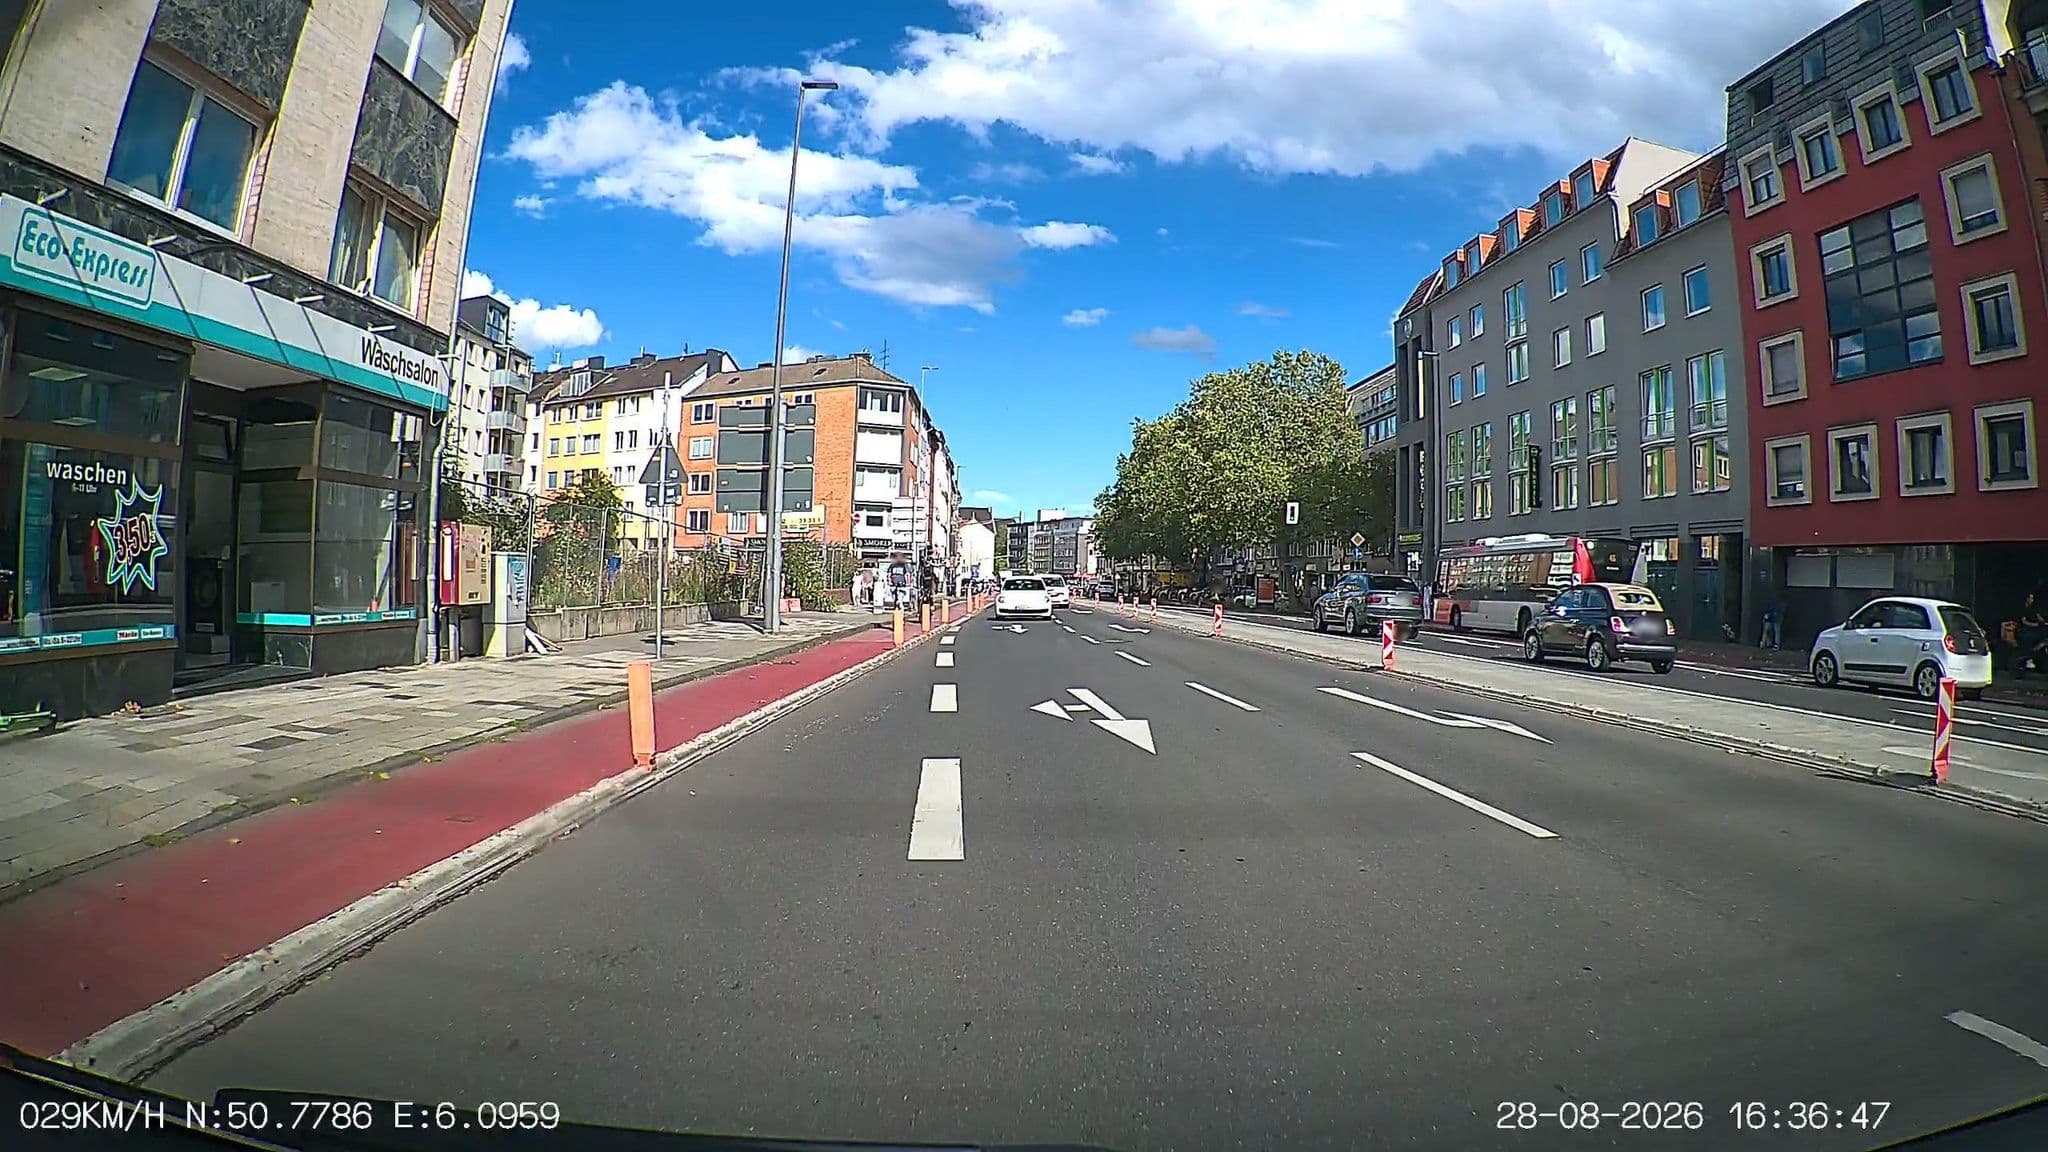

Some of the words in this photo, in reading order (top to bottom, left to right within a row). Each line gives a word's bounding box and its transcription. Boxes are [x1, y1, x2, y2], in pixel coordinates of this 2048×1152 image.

[22, 219, 148, 289] Eco-Express
[360, 337, 440, 388] Waschsalon
[46, 462, 127, 485] waschen
